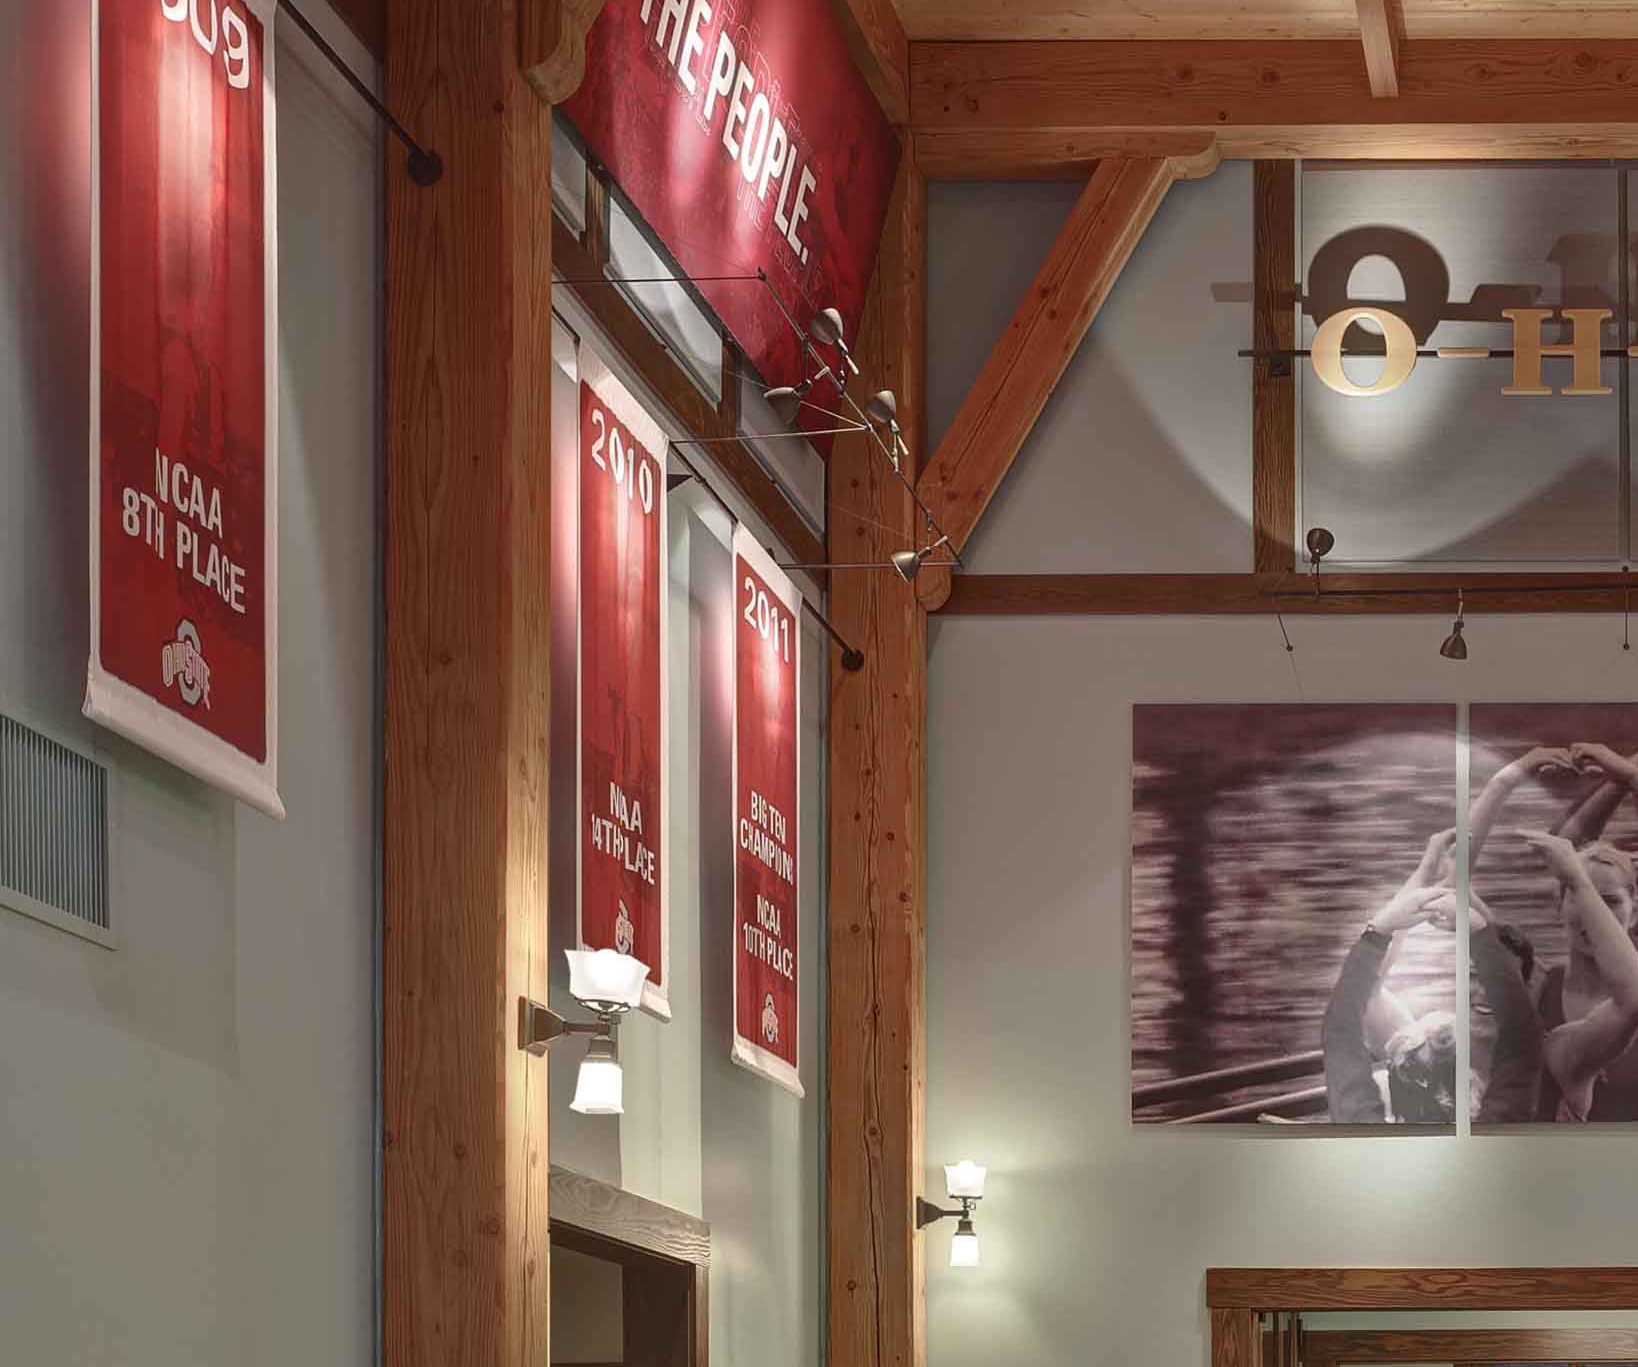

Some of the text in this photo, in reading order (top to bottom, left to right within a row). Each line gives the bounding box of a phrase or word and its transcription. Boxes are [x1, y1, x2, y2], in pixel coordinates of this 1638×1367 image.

[703, 30, 817, 266] PEOPLE.
[155, 447, 223, 539] NCAA
[591, 409, 653, 514] 2010
[122, 487, 246, 615] 8TH PLACE
[744, 576, 789, 664] 2011
[610, 781, 643, 835] NAA
[740, 818, 793, 885] CHAMPION
[751, 790, 768, 830] BIG
